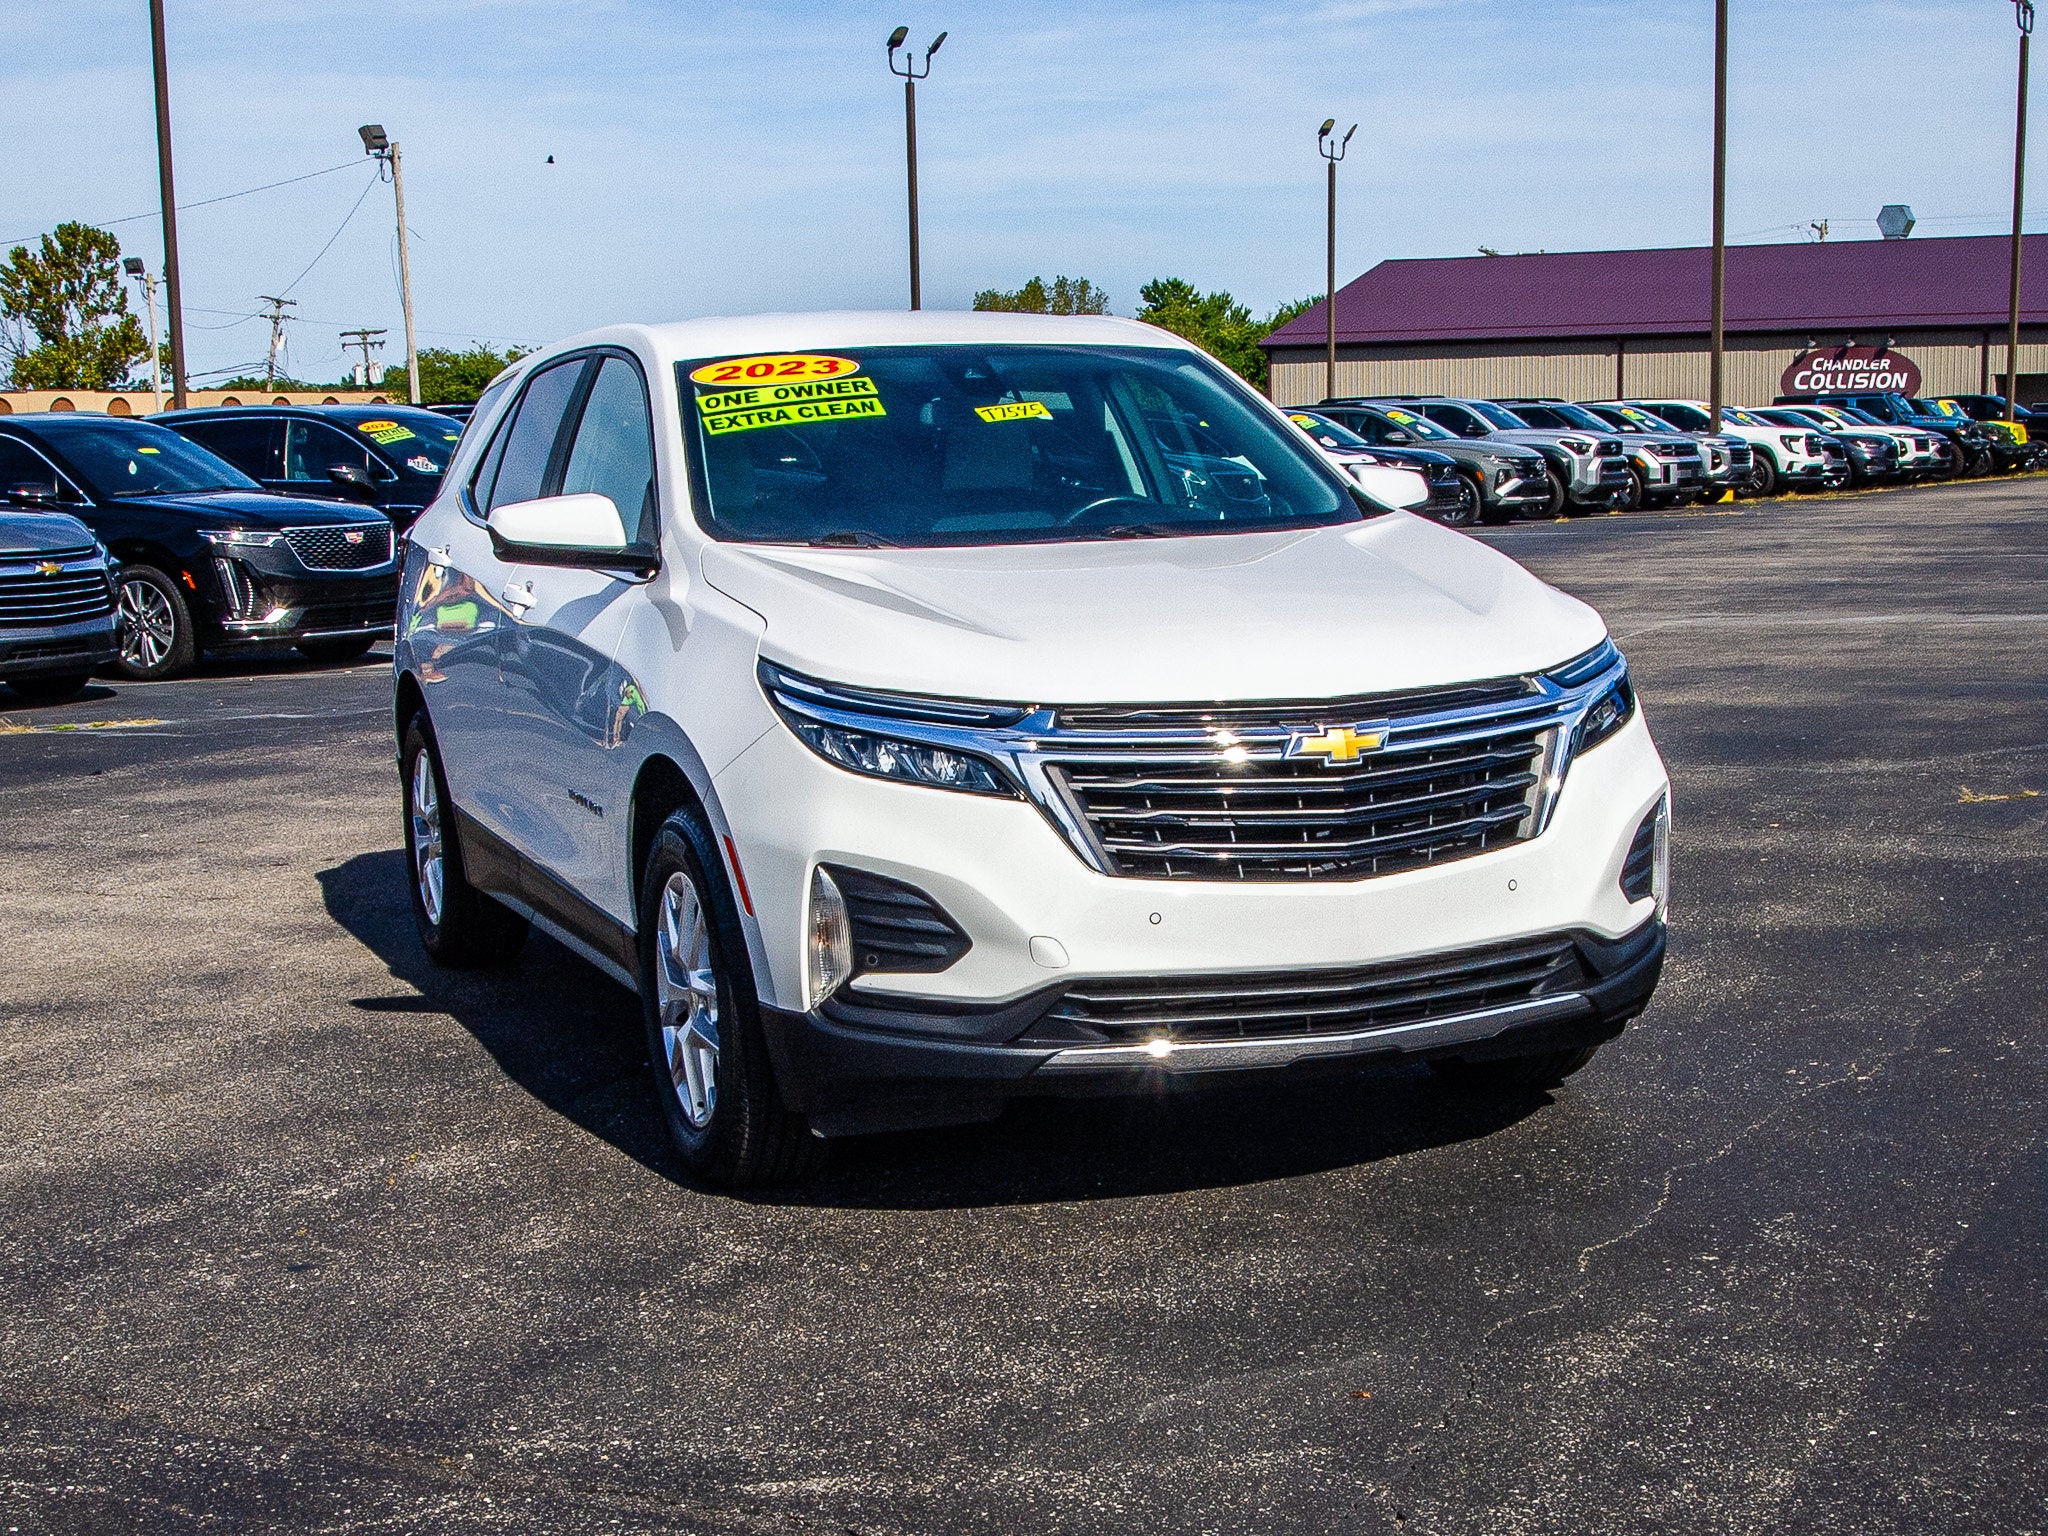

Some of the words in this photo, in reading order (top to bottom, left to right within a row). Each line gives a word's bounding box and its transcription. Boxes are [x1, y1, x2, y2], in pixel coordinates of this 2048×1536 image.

[711, 360, 842, 382] 2023
[1812, 357, 1891, 372] CHANDLER
[1793, 370, 1909, 390] COLLISION
[705, 391, 760, 410] ONE
[773, 380, 872, 400] OWNER
[708, 408, 792, 431] EXTRA
[797, 400, 876, 419] CLEAN
